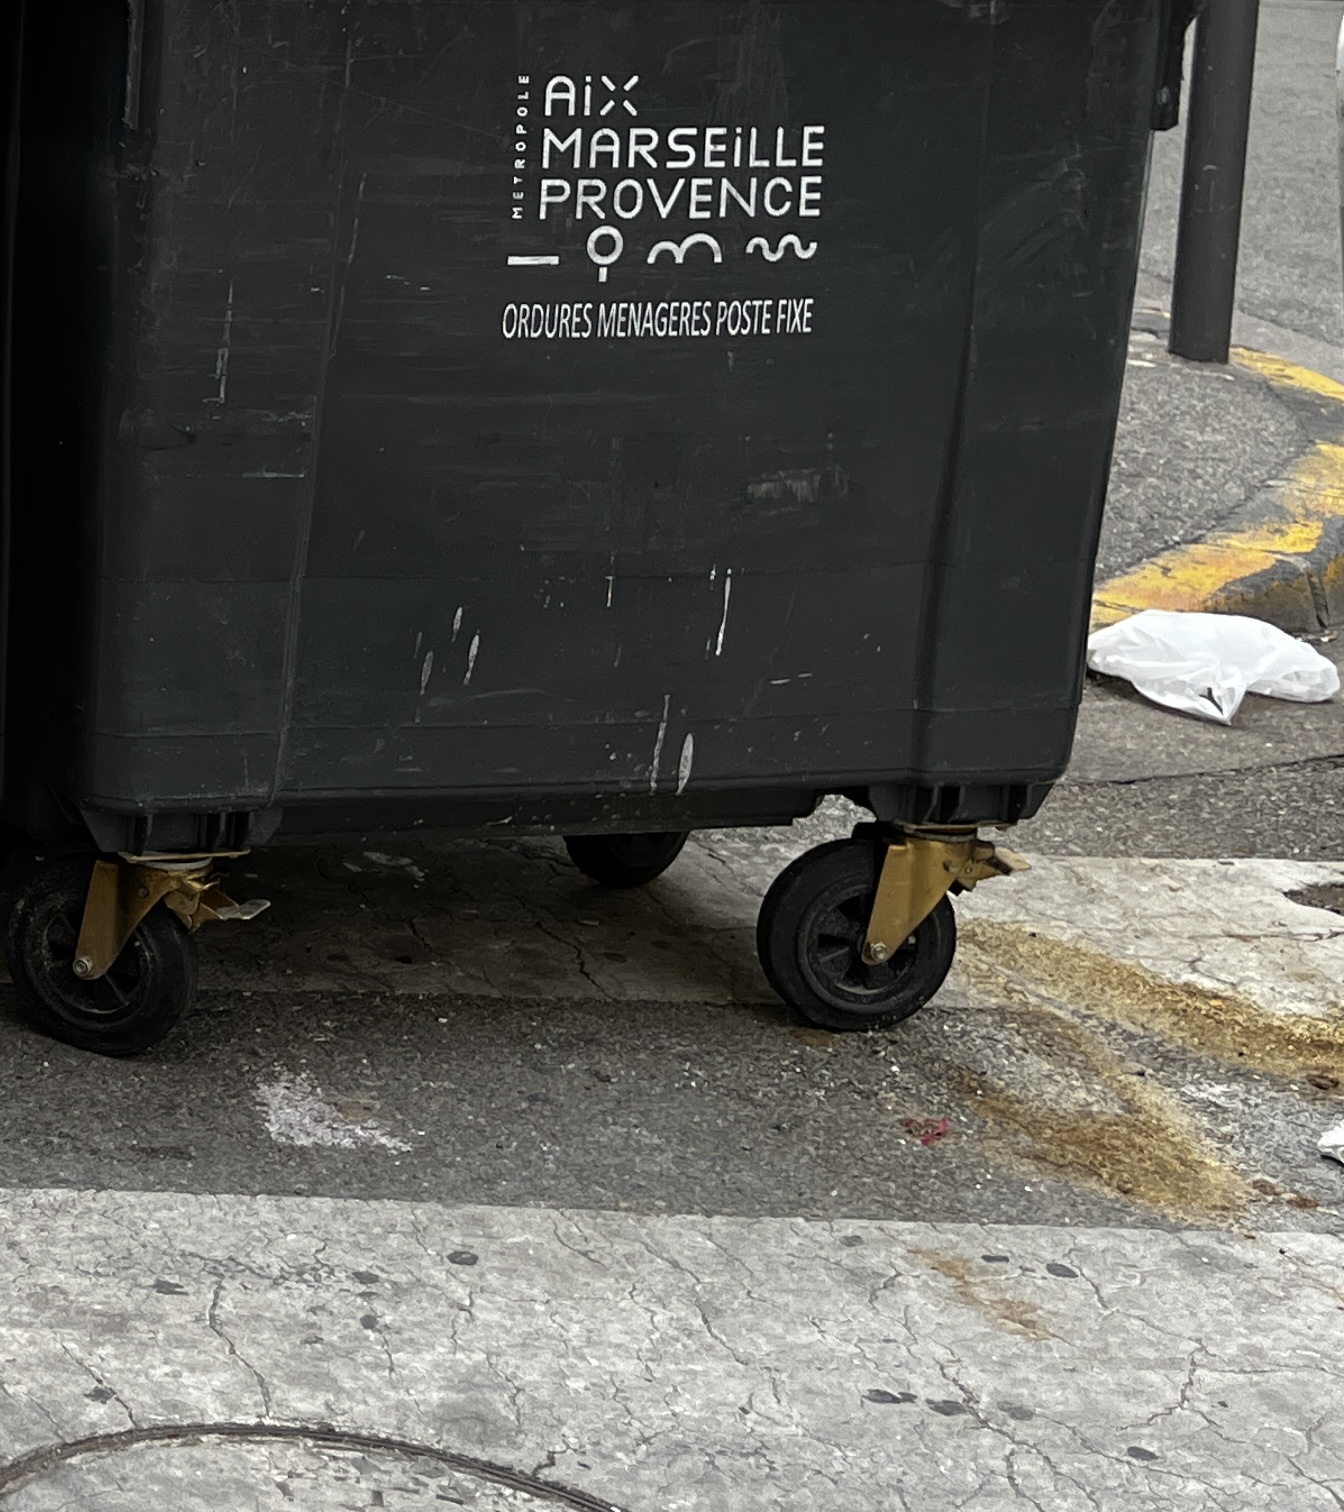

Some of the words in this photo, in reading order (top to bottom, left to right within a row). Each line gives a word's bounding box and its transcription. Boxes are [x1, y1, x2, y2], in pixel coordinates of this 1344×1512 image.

[511, 75, 530, 220] METROPOLE
[539, 176, 823, 220] PROVENCE
[502, 302, 593, 339] ORDURES
[596, 301, 712, 338] MENAGERES
[716, 299, 773, 336] POSTE
[776, 298, 815, 334] FIXE
